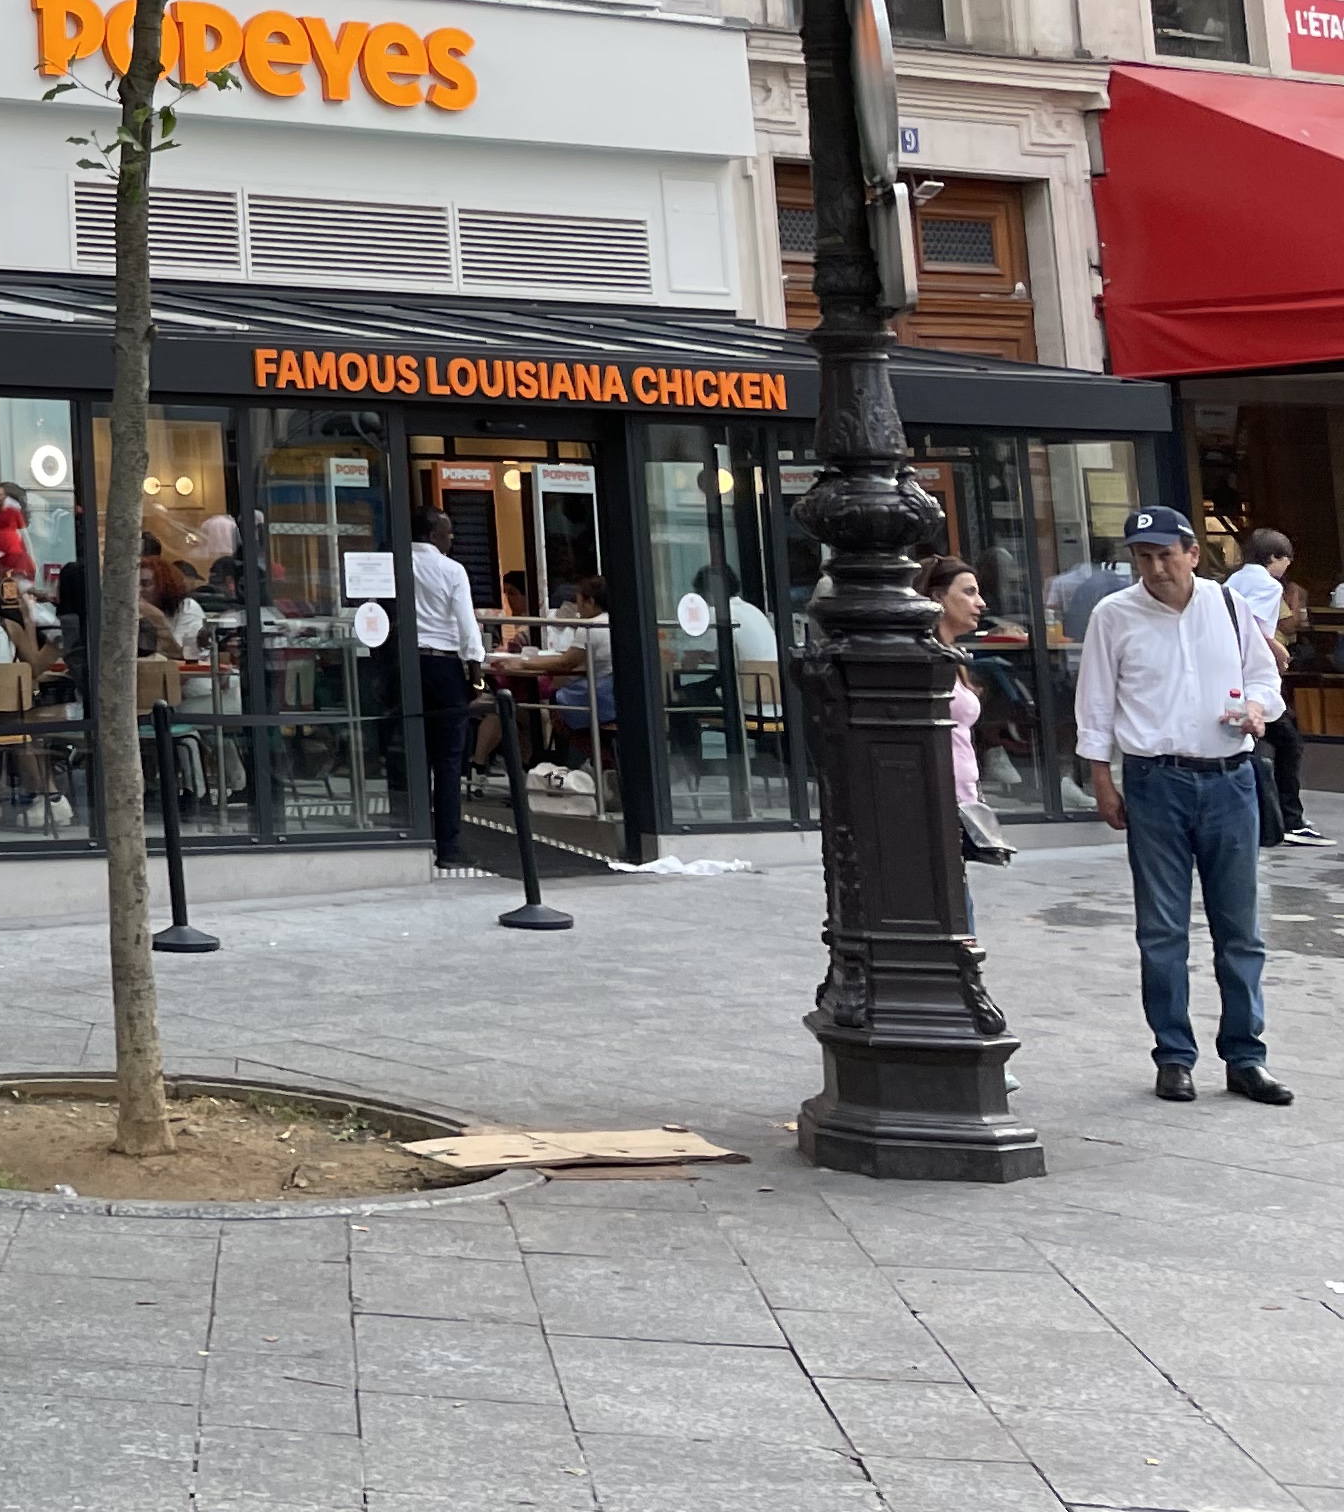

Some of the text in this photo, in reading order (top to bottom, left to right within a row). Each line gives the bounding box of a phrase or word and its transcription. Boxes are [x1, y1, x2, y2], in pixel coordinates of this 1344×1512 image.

[1295, 5, 1344, 40] L'ÉTA
[904, 128, 916, 151] 9
[253, 348, 788, 412] FAMOUS LOUISIANA CHICKEN
